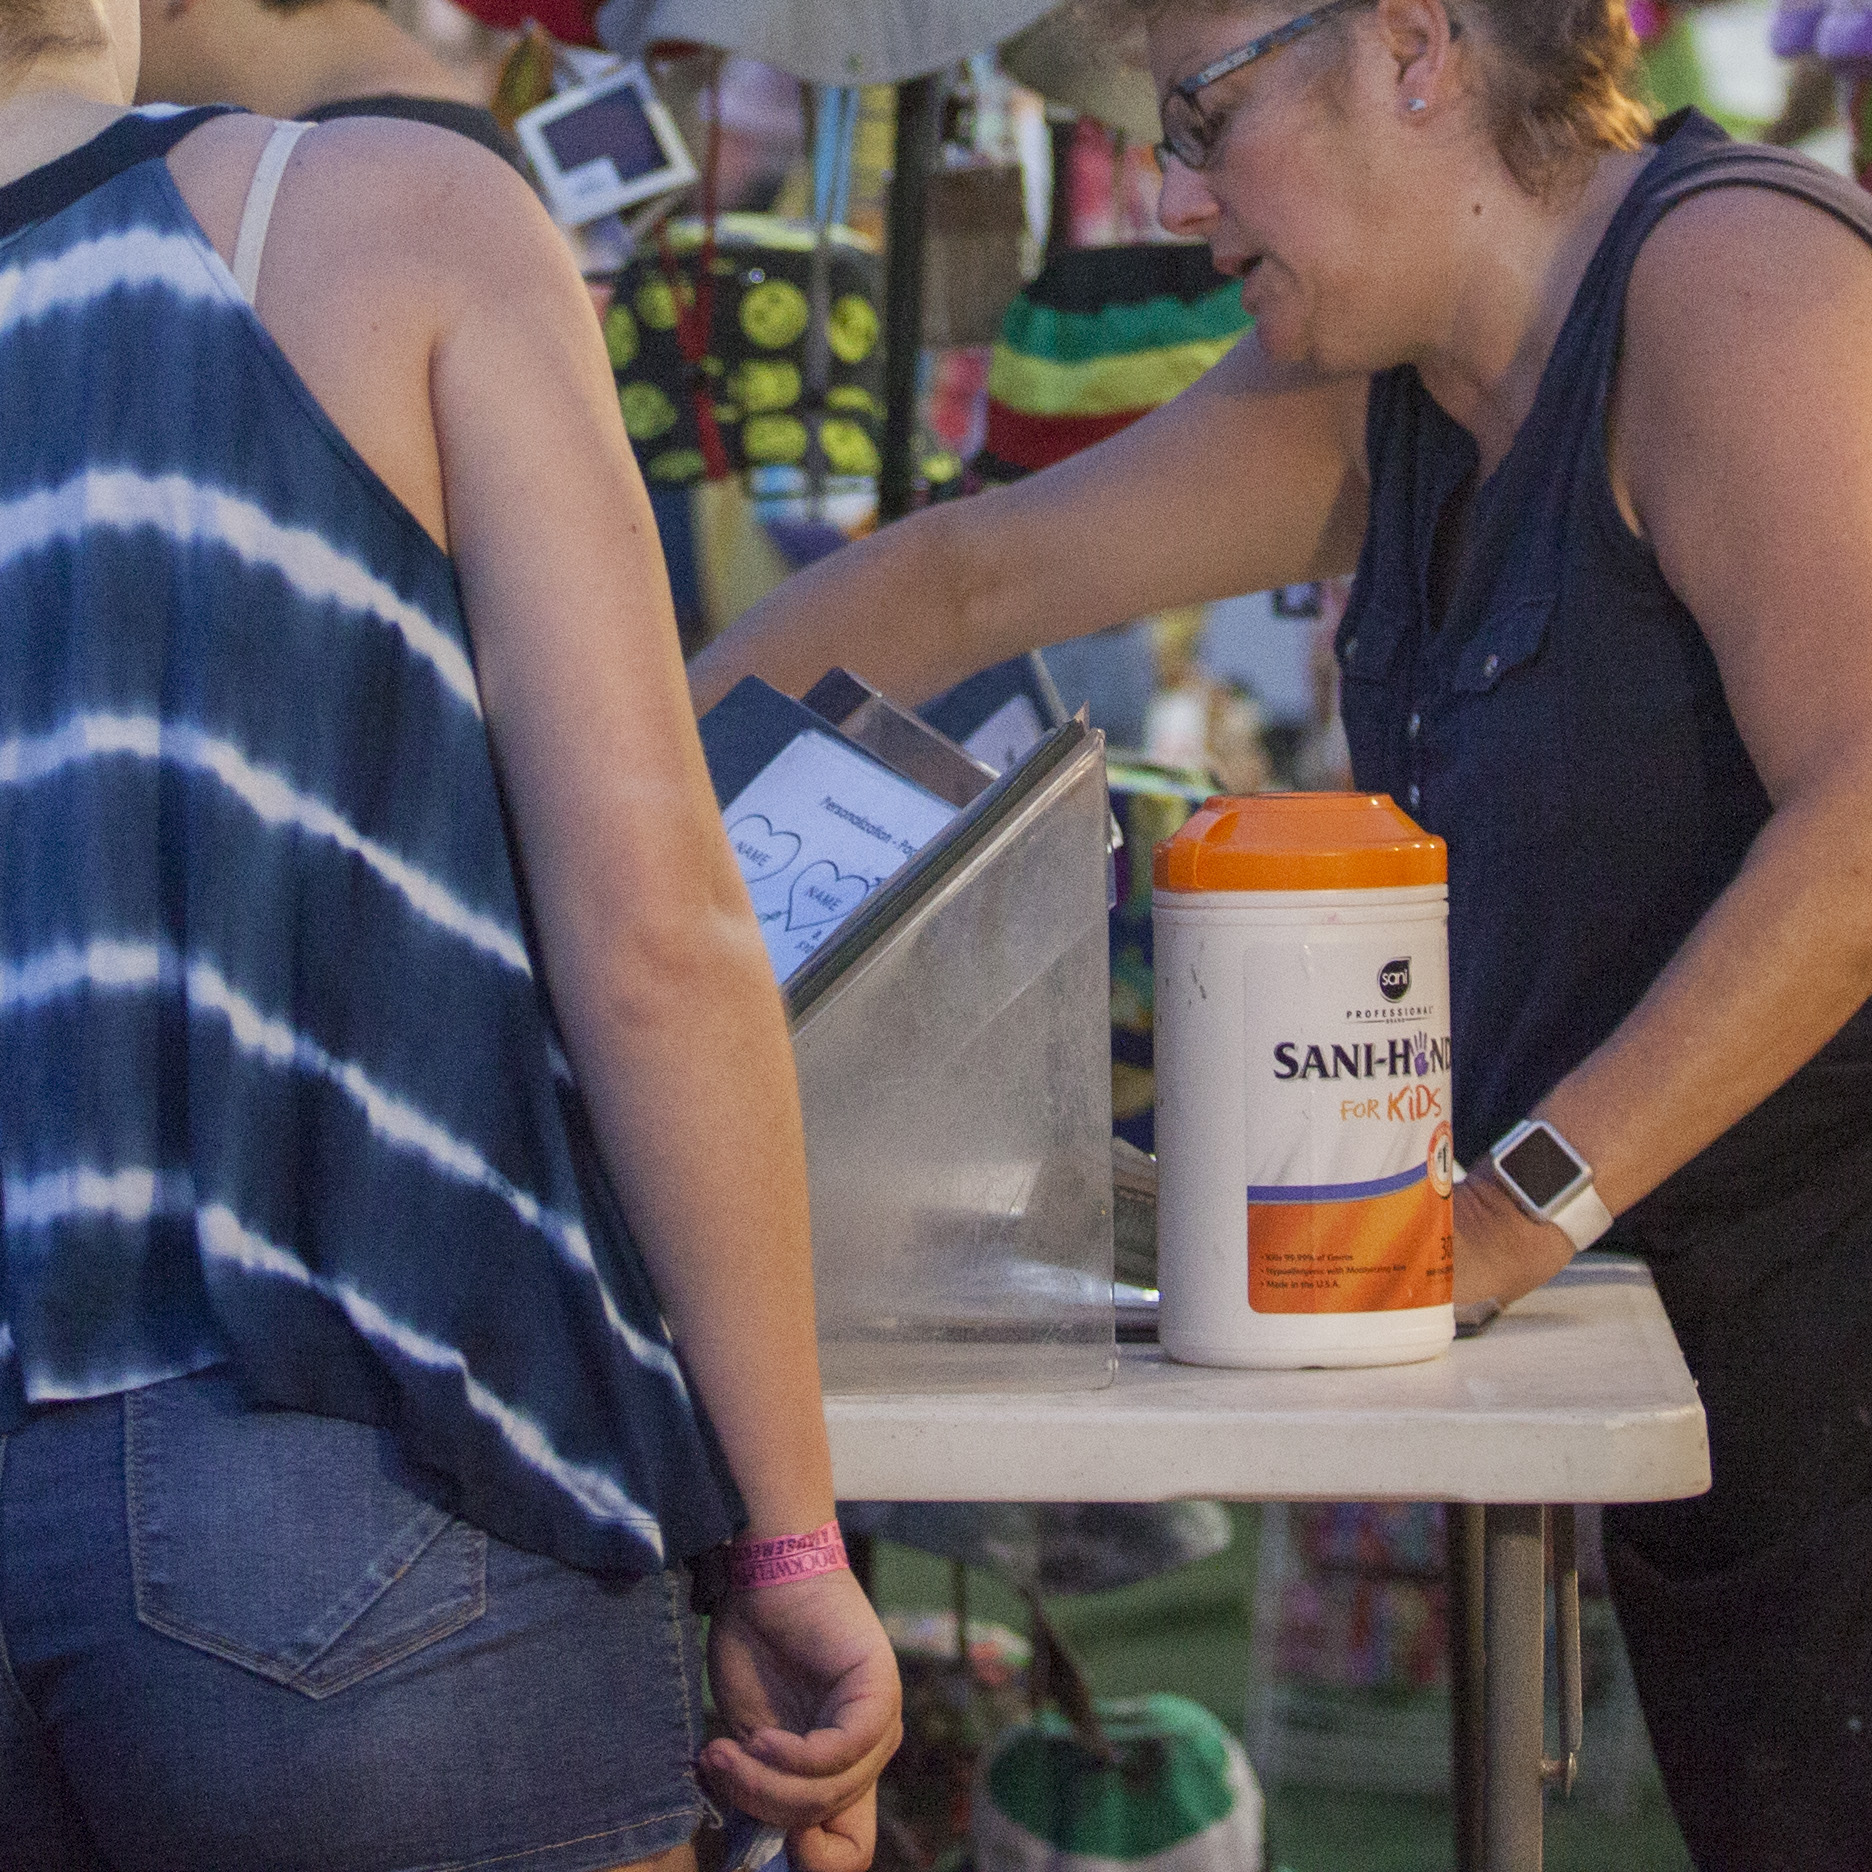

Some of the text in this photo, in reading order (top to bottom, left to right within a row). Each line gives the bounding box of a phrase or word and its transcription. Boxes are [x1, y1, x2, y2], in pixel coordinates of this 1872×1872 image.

[820, 795, 893, 846] Personalization
[736, 840, 772, 868] NAME
[805, 885, 843, 912] NAME
[1381, 968, 1409, 987] sani
[1345, 1004, 1433, 1020] PROFESSIONAL
[1339, 1098, 1381, 1122] FOR
[1266, 1280, 1288, 1289] Made
[1290, 1280, 1299, 1289] in
[1300, 1280, 1315, 1289] the
